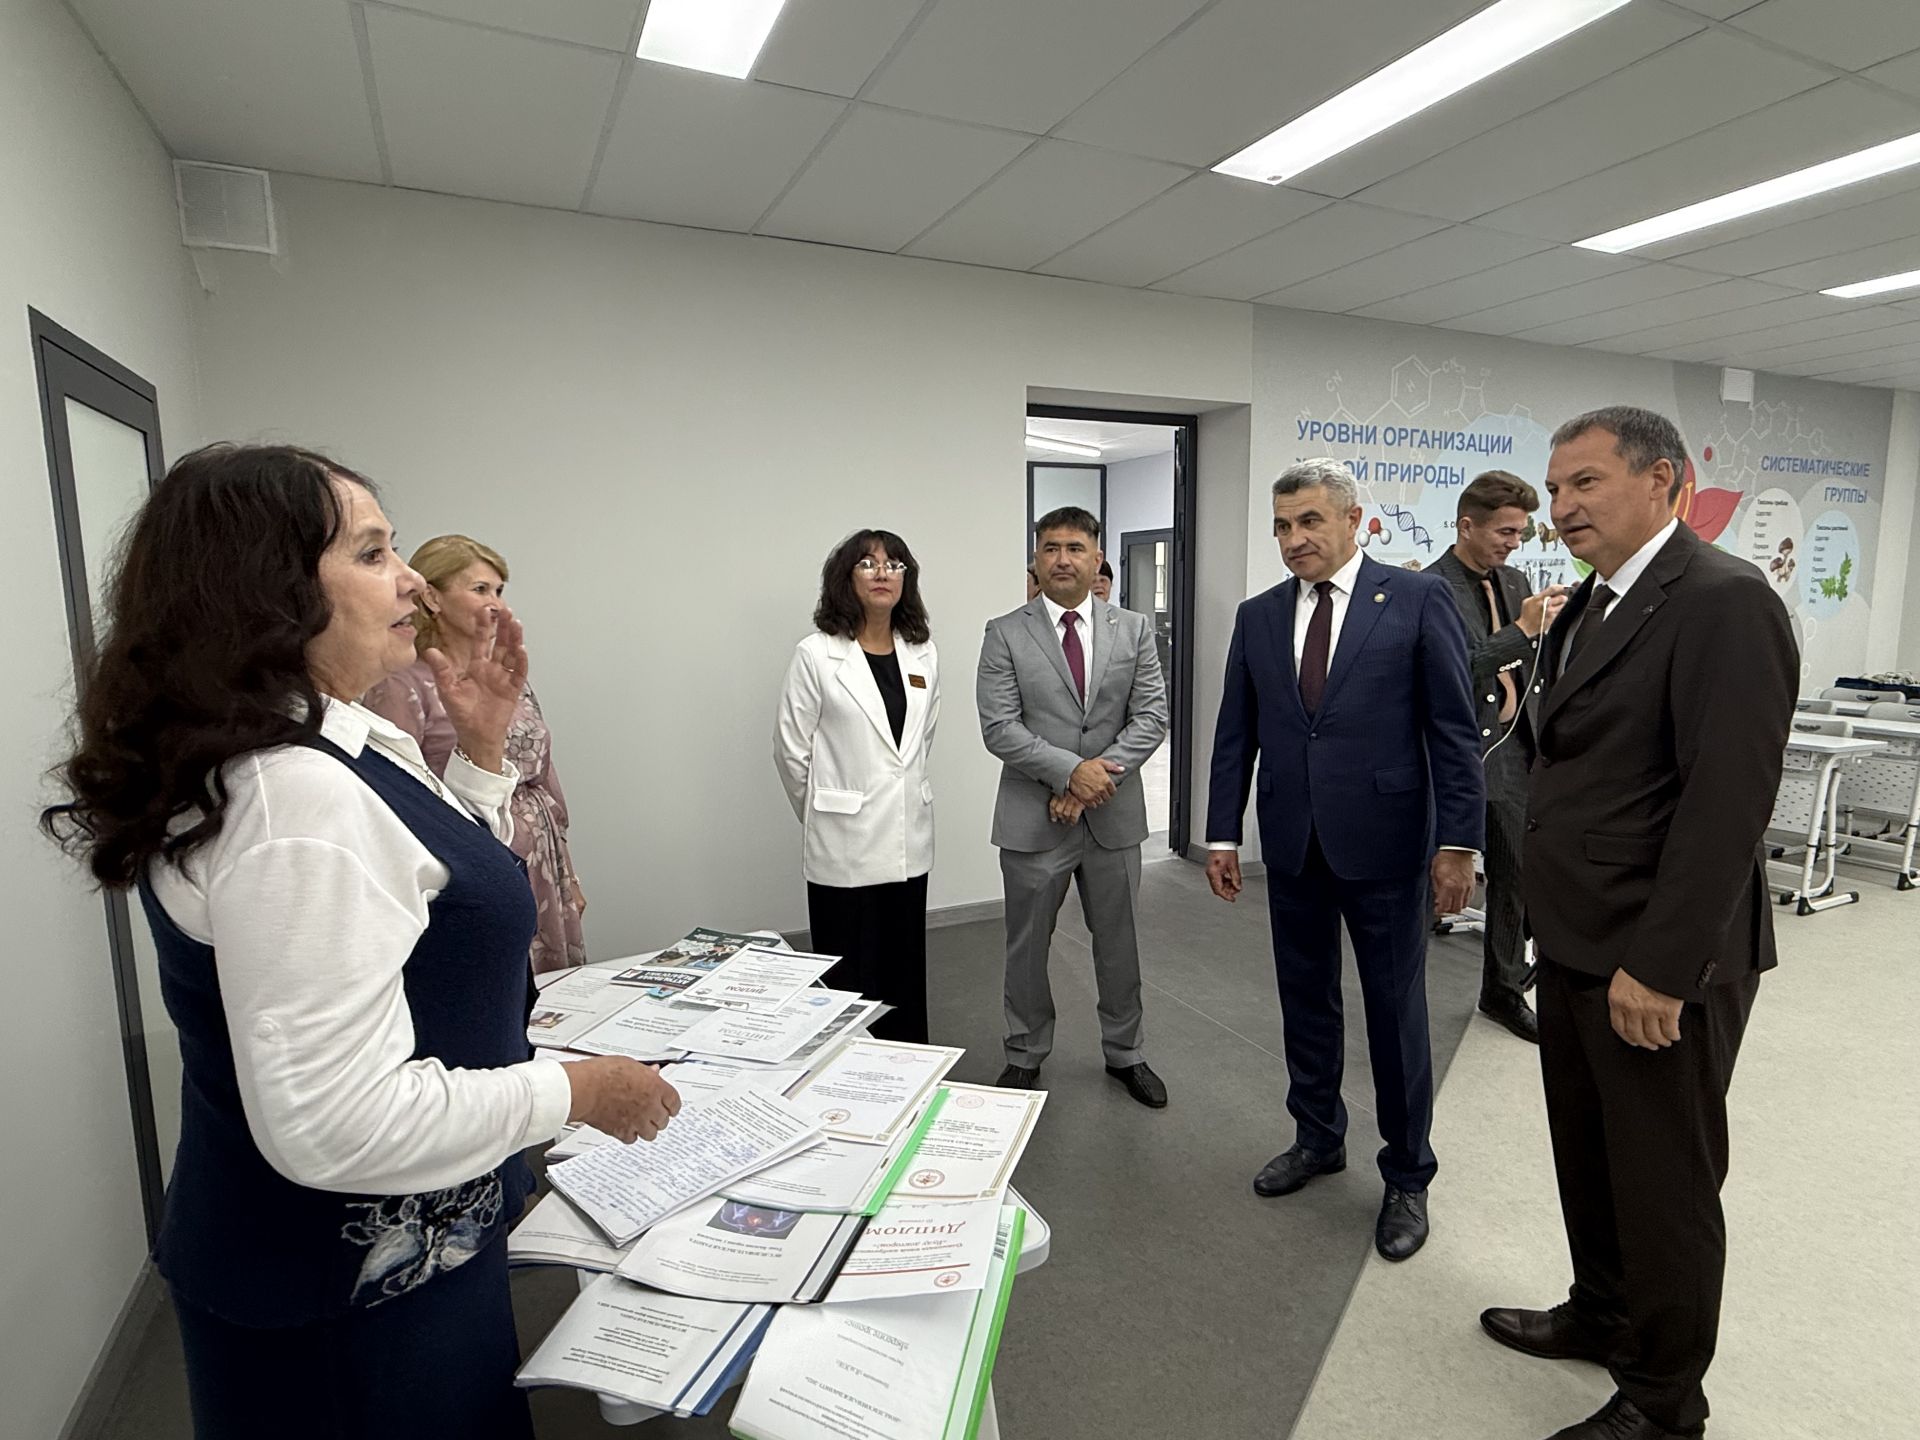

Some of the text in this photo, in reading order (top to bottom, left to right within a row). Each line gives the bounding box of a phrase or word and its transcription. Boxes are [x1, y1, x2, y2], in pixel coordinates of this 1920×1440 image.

[1297, 420, 1512, 456] УРОВНИ ОРГАНИЗАЦИИ
[1374, 462, 1465, 488] ПРИРОДЫ
[1761, 455, 1870, 477] СИСТЕМАТИЧЕСКИЕ
[1824, 486, 1867, 503] ГРУППЫ
